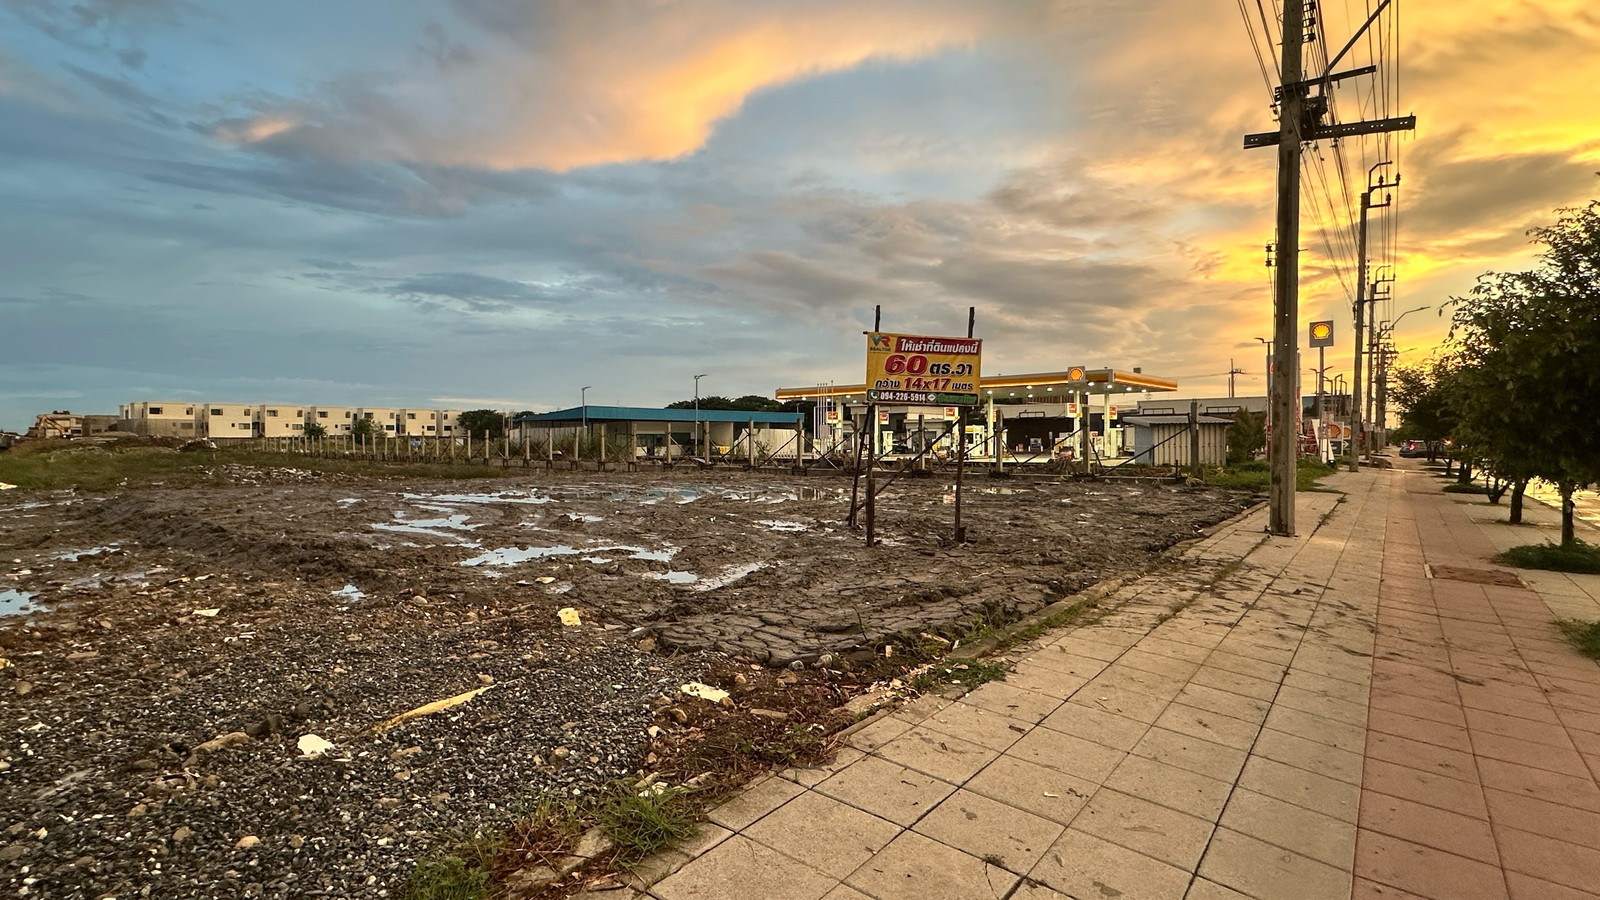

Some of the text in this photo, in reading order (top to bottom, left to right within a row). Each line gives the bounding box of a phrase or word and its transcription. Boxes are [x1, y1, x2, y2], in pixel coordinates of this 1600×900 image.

[900, 339, 979, 353] ให้เช่าที่ดินแปลงนี้
[884, 353, 973, 376] 60 ตร.วา
[875, 376, 973, 391] กว้าง 14x17 เมตร
[880, 391, 926, 401] 094-226-5914
